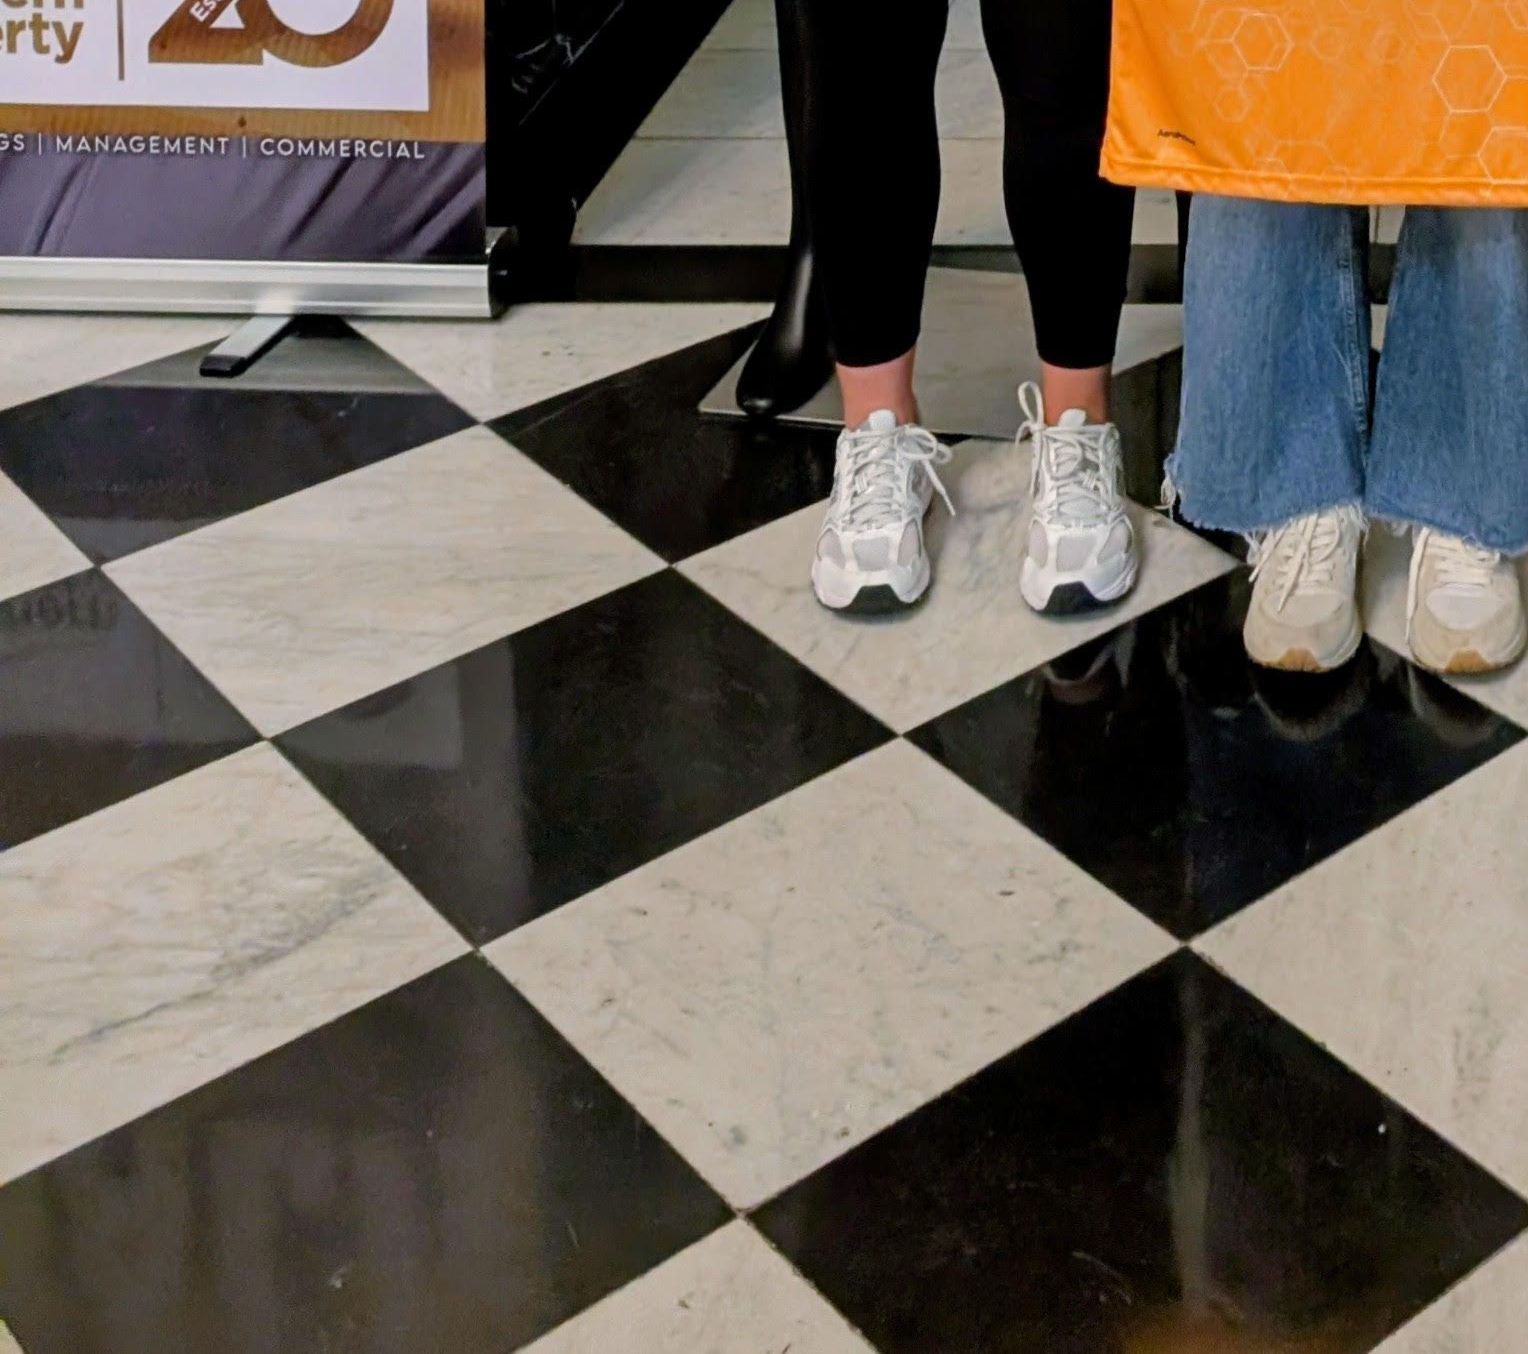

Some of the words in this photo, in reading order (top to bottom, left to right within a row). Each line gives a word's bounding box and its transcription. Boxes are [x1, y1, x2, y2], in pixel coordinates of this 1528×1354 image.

[0, 12, 84, 65] rty
[55, 134, 230, 156] MANAGEMENT
[259, 137, 426, 160] COMMERCIAL
